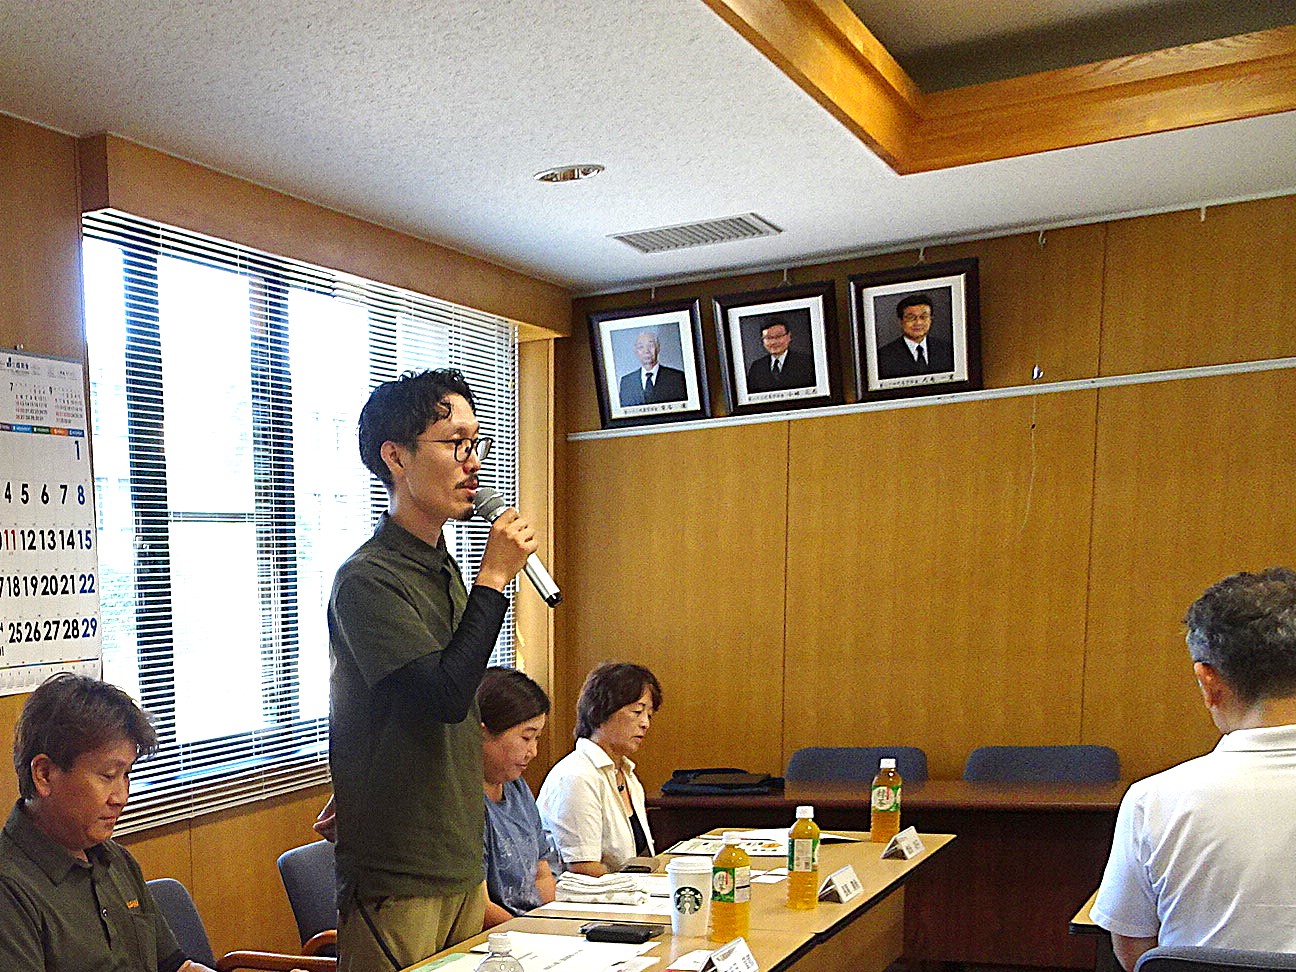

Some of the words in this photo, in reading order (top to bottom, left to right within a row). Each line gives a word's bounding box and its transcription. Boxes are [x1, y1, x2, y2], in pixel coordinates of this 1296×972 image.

[74, 440, 81, 460] 1
[4, 481, 12, 504] 4
[20, 483, 30, 505] 5
[40, 484, 50, 505] 6
[59, 484, 68, 505] 7
[77, 484, 86, 506] 8
[4, 529, 17, 551] 11
[20, 529, 37, 551] 12
[39, 529, 56, 551] 13
[58, 529, 75, 551] 14
[77, 529, 92, 550] 15
[6, 575, 21, 597] 18
[22, 575, 38, 597] 19
[40, 574, 59, 596] 20
[60, 574, 76, 595] 21
[79, 573, 96, 594] 22
[8, 622, 23, 644] 25
[24, 621, 41, 643] 26
[43, 620, 61, 641] 27
[62, 618, 80, 640] 28
[81, 617, 98, 638] 29
